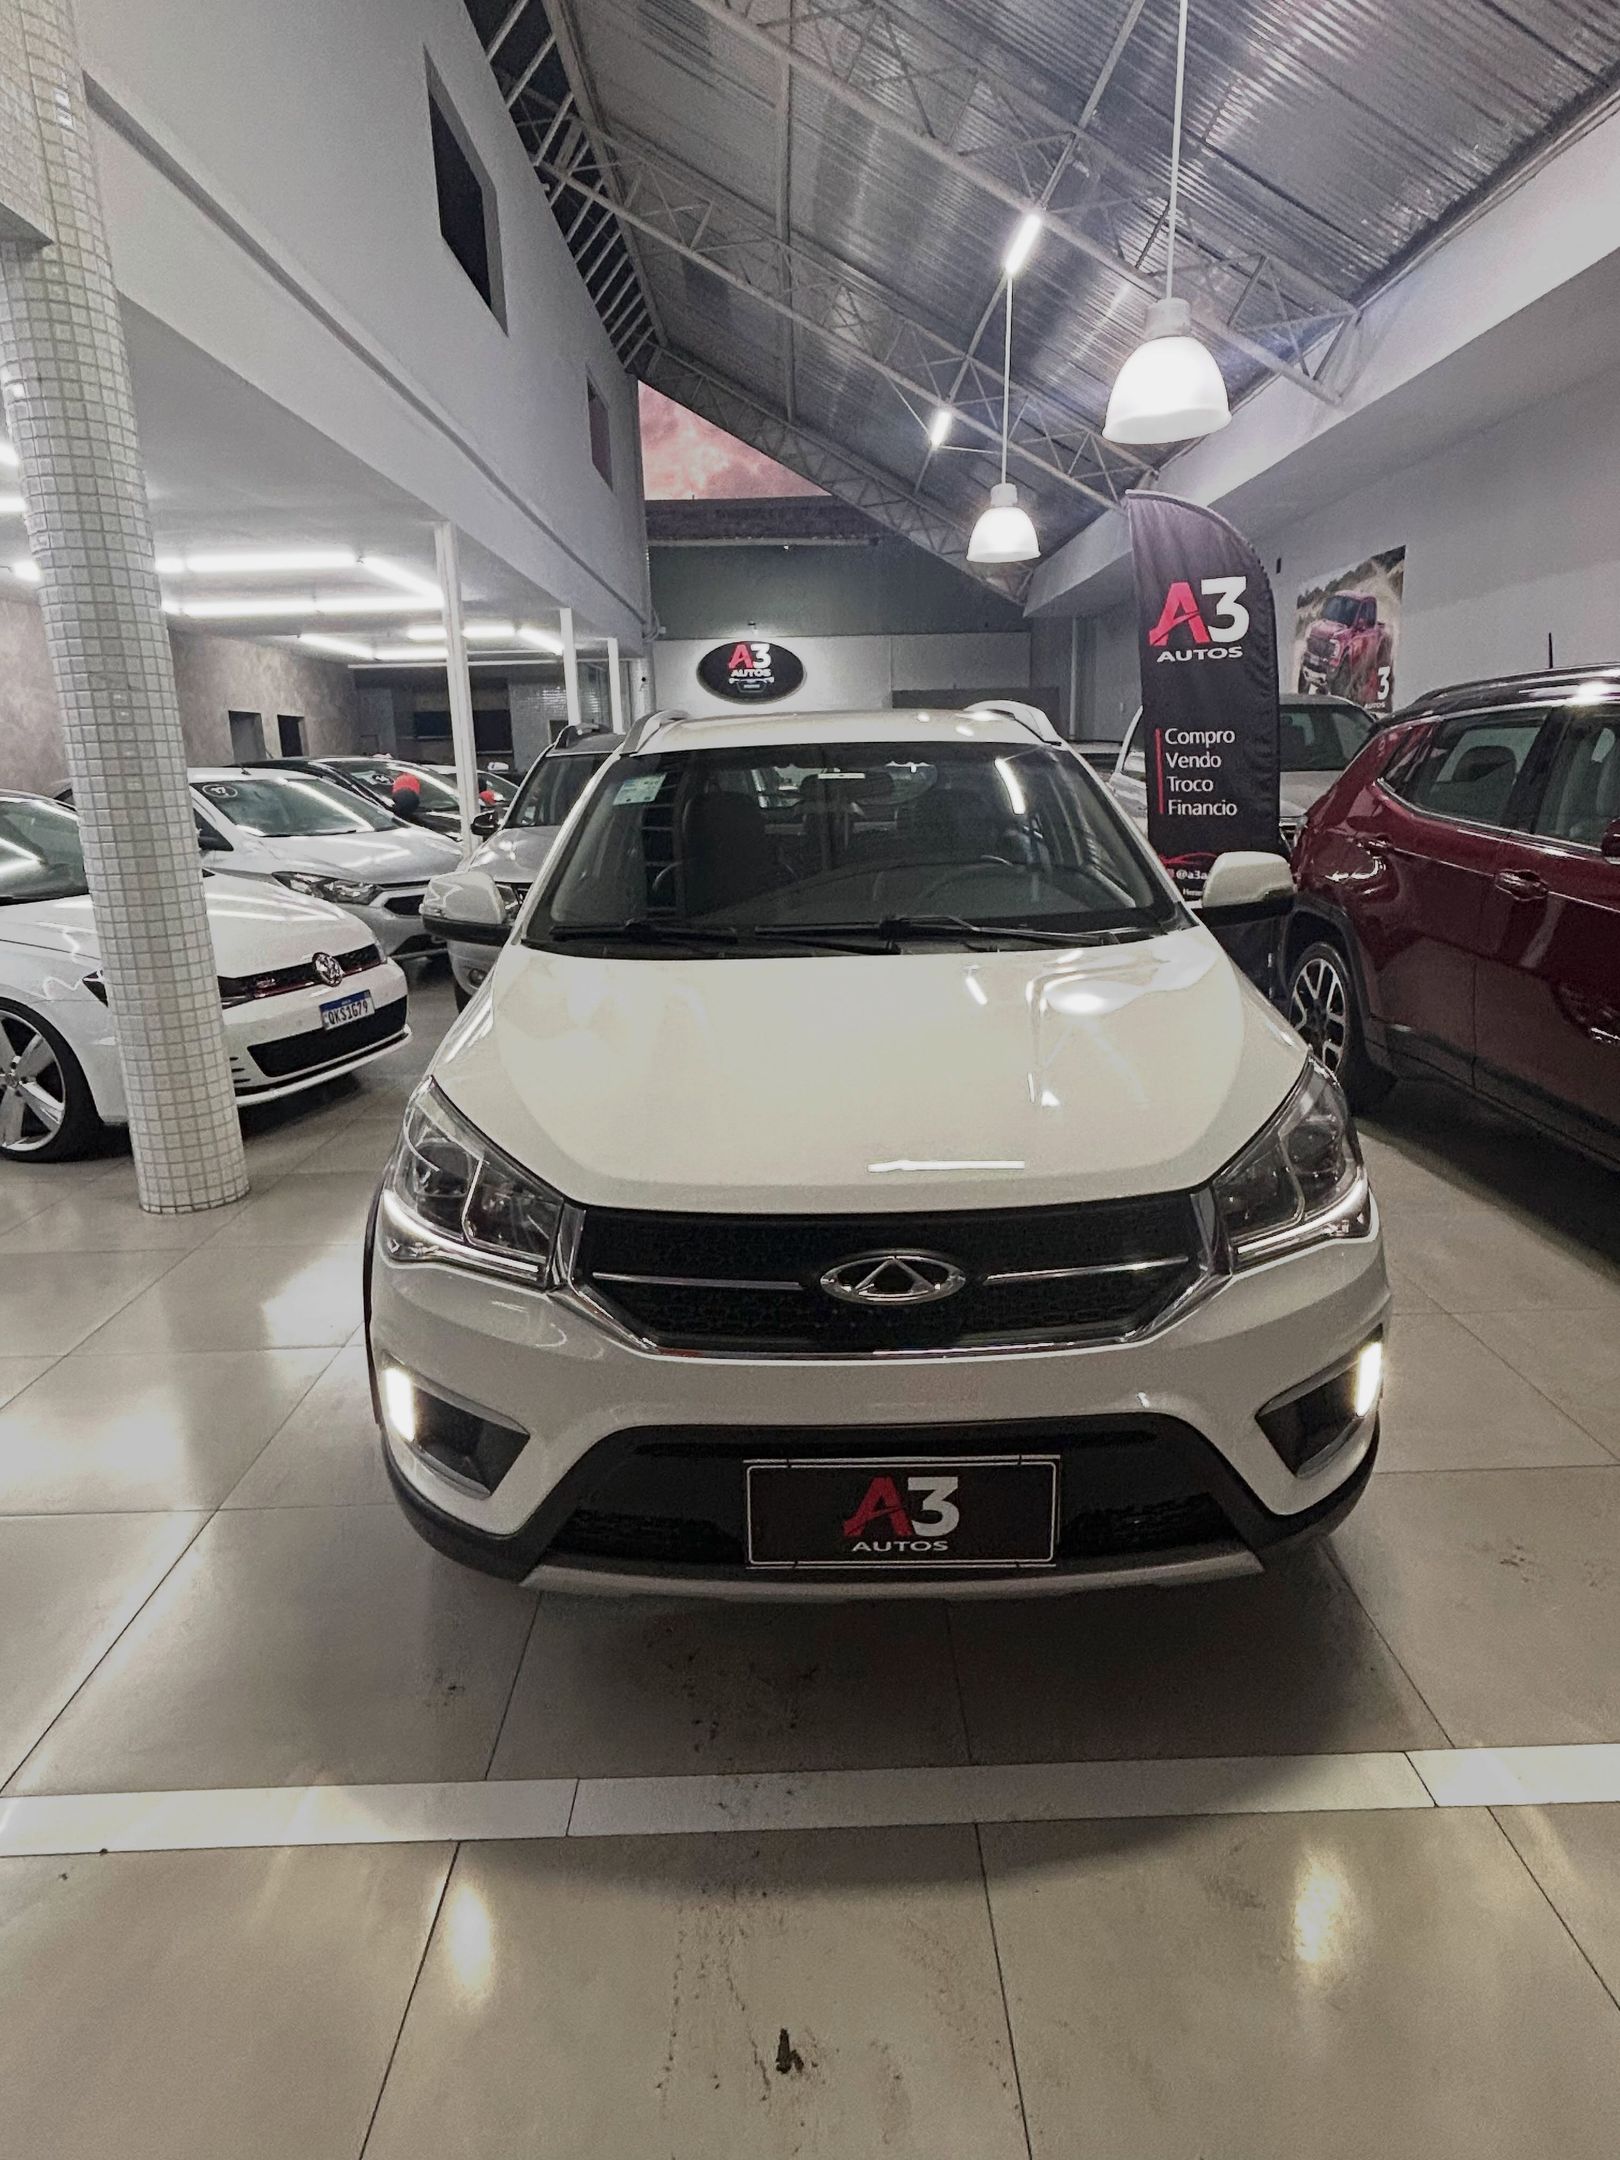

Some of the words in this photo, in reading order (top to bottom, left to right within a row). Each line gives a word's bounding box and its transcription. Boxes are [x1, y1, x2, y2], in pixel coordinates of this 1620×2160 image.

[1148, 576, 1250, 646] A3
[728, 643, 772, 669] A3
[1156, 646, 1243, 663] AUTOS
[730, 668, 772, 678] AUTOS
[1164, 727, 1236, 748] Compro
[1165, 750, 1222, 769] Vendo
[1166, 775, 1214, 792] Troco
[1168, 799, 1238, 816] Financio
[842, 1476, 960, 1537] A3
[852, 1540, 949, 1552] AUTOS
